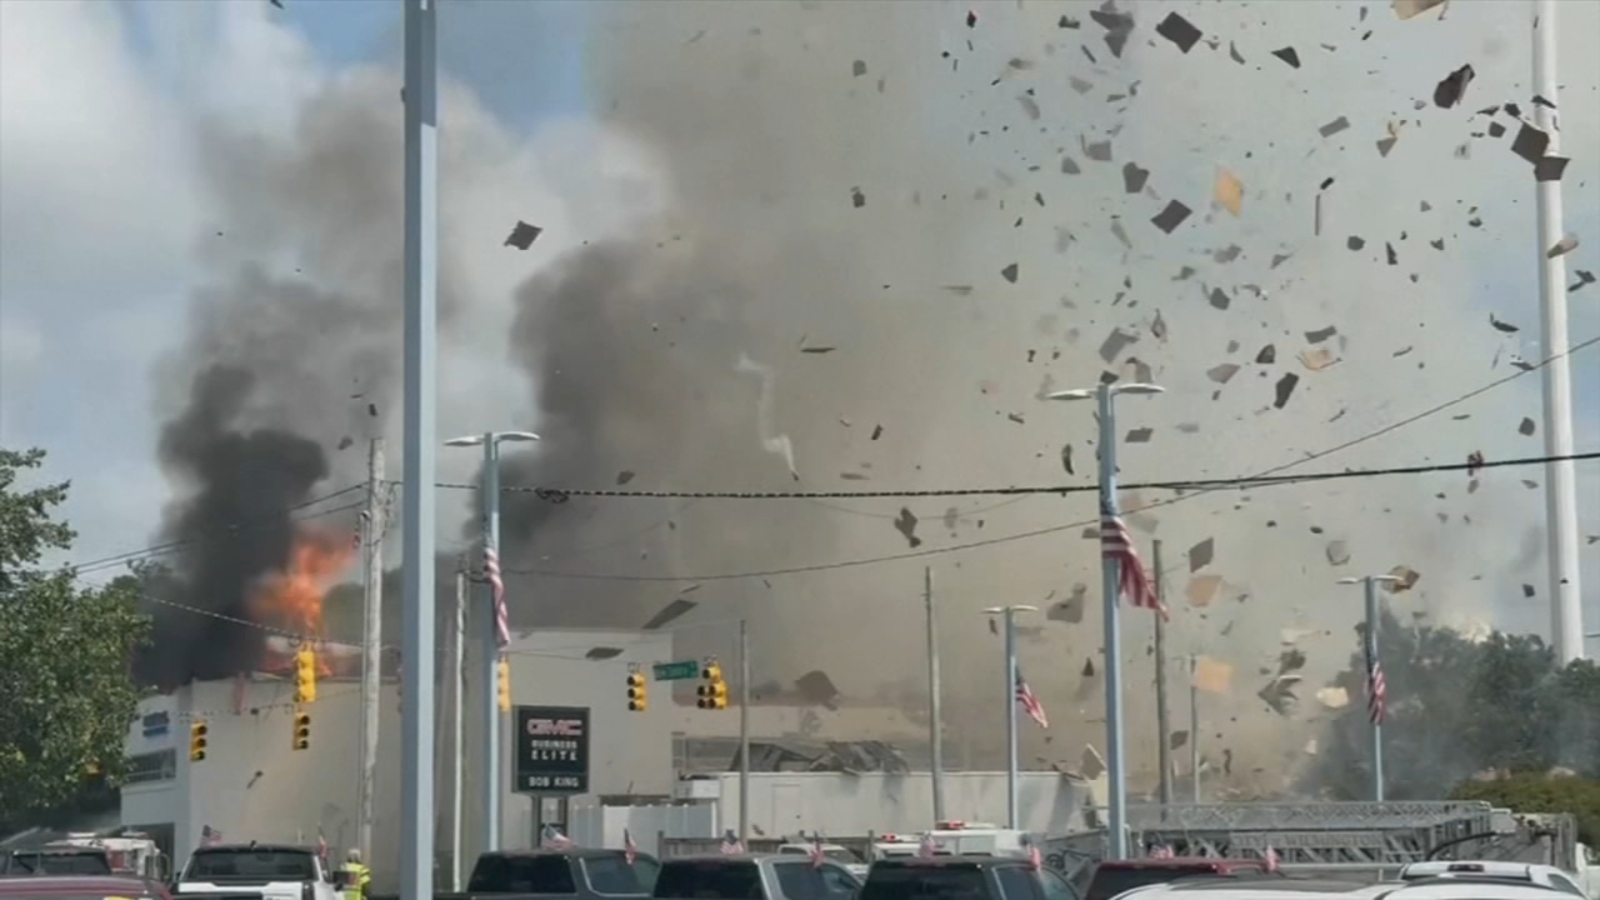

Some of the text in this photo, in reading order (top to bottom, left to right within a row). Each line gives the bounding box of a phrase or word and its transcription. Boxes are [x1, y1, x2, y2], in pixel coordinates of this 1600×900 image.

[527, 719, 582, 735] GMC
[531, 740, 577, 749] BUSINESS
[531, 750, 577, 760] ELITE
[529, 776, 579, 787] BOB KING
